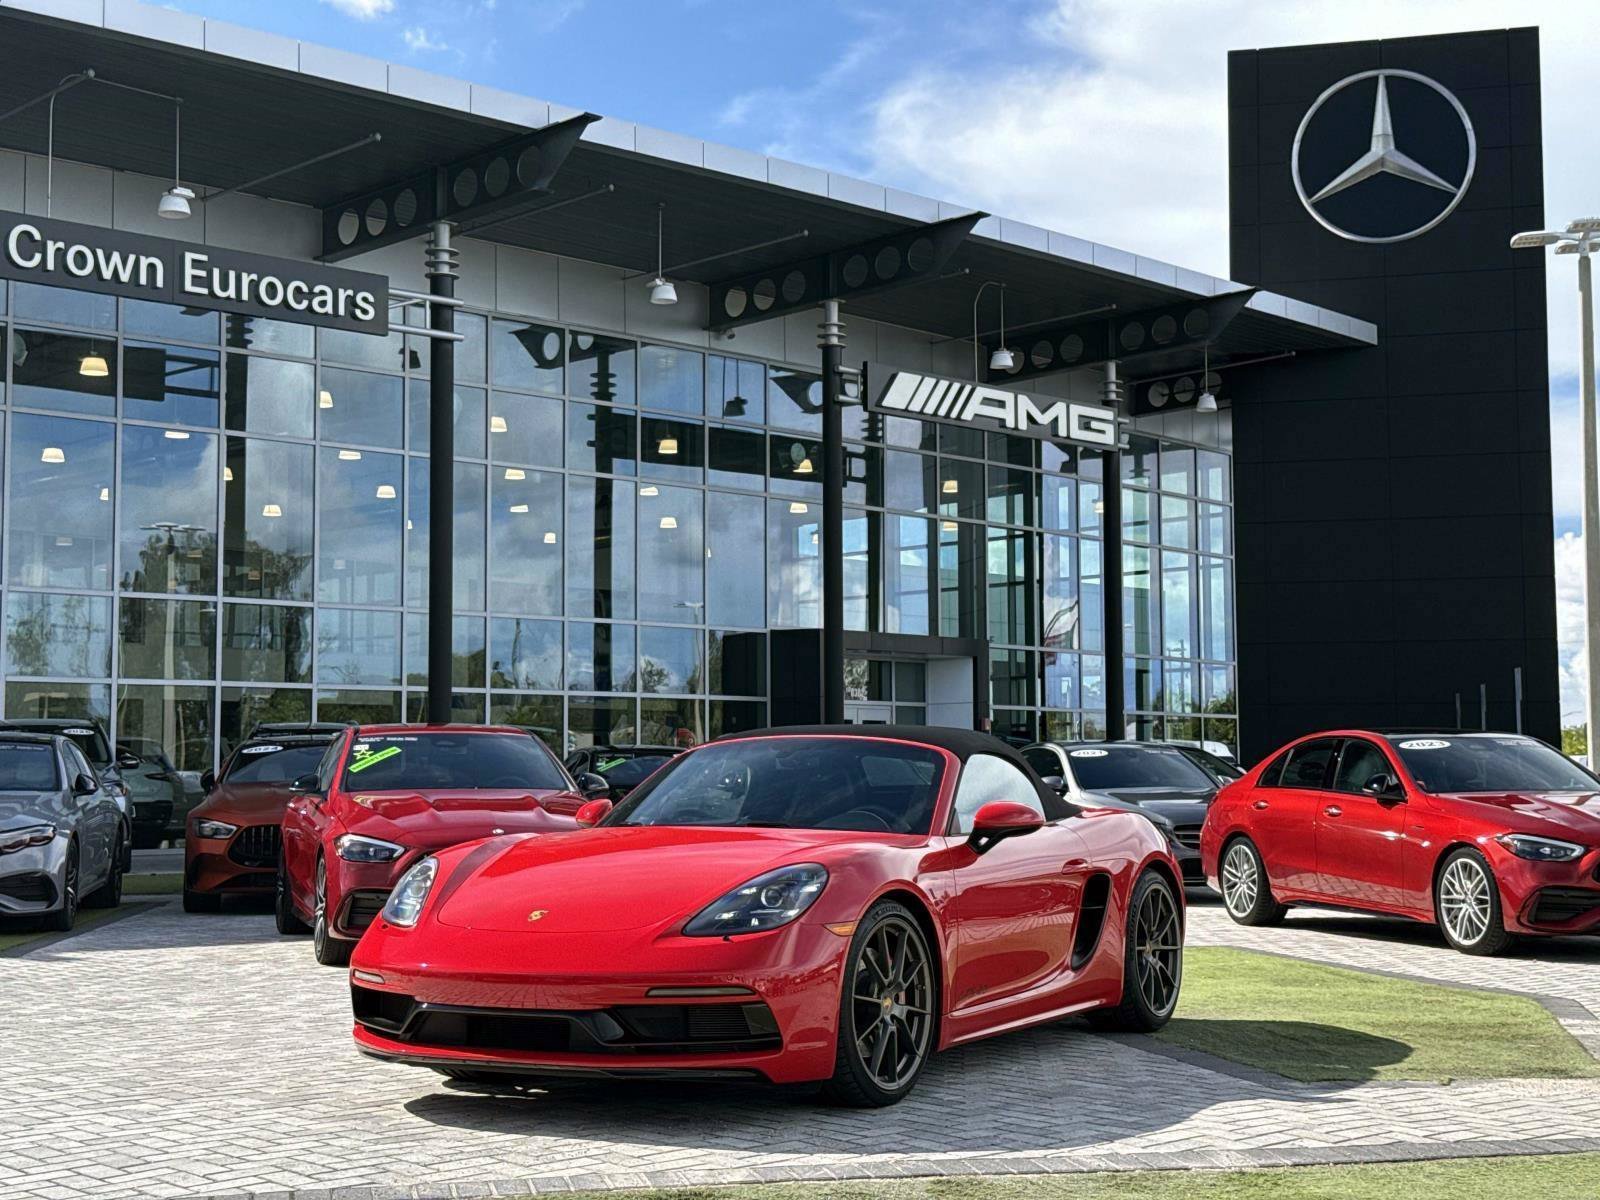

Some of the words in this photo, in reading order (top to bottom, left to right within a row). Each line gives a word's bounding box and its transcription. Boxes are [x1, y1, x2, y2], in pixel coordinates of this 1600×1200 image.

[7, 223, 165, 289] Crown
[183, 250, 377, 322] Eurocars
[960, 385, 1115, 446] AMG
